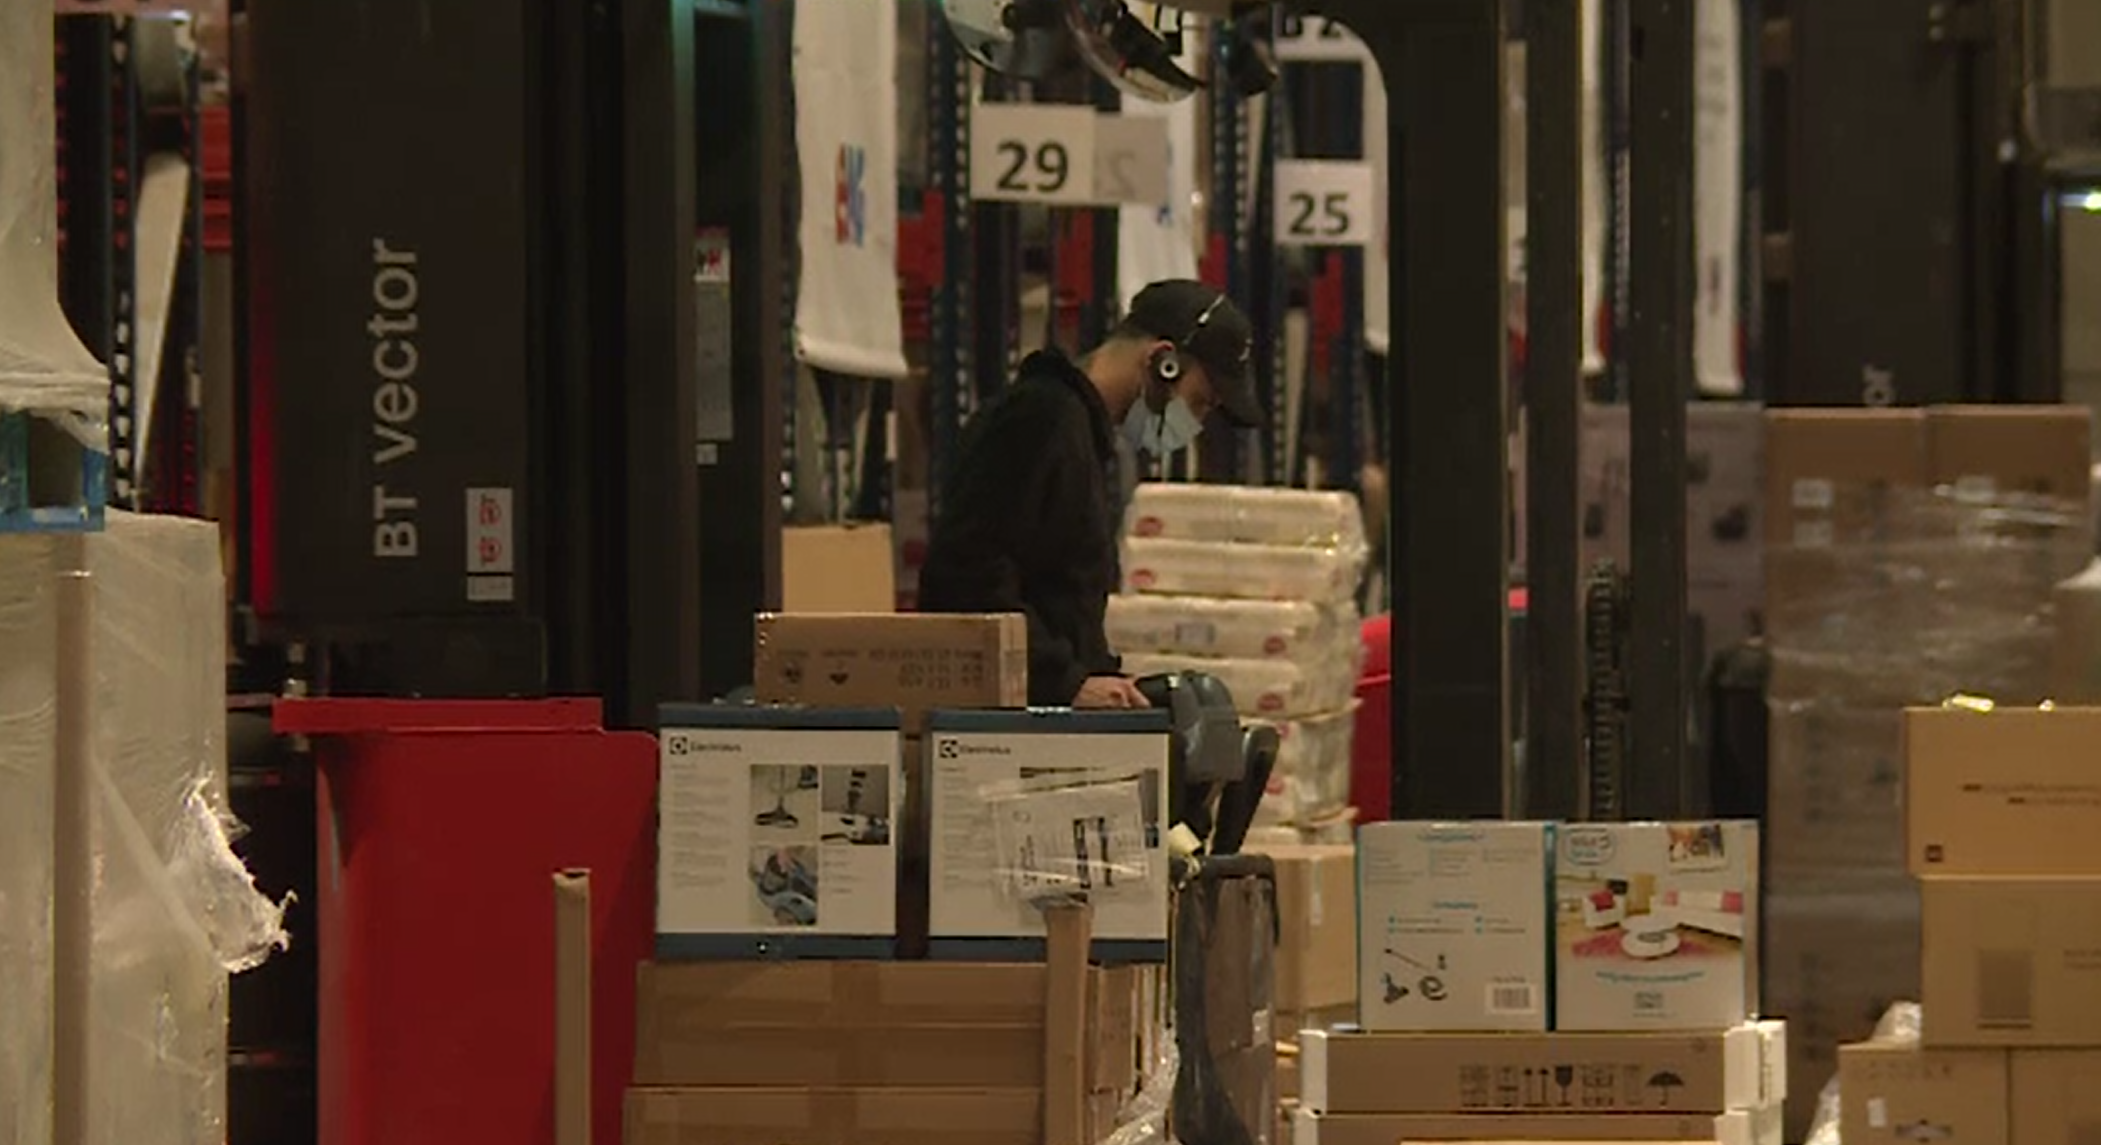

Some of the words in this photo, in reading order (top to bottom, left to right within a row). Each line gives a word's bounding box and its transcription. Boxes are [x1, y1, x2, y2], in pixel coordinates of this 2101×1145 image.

[996, 138, 1069, 193] 29
[1288, 191, 1349, 236] 25
[367, 238, 418, 463] vector
[374, 485, 418, 556] BT
